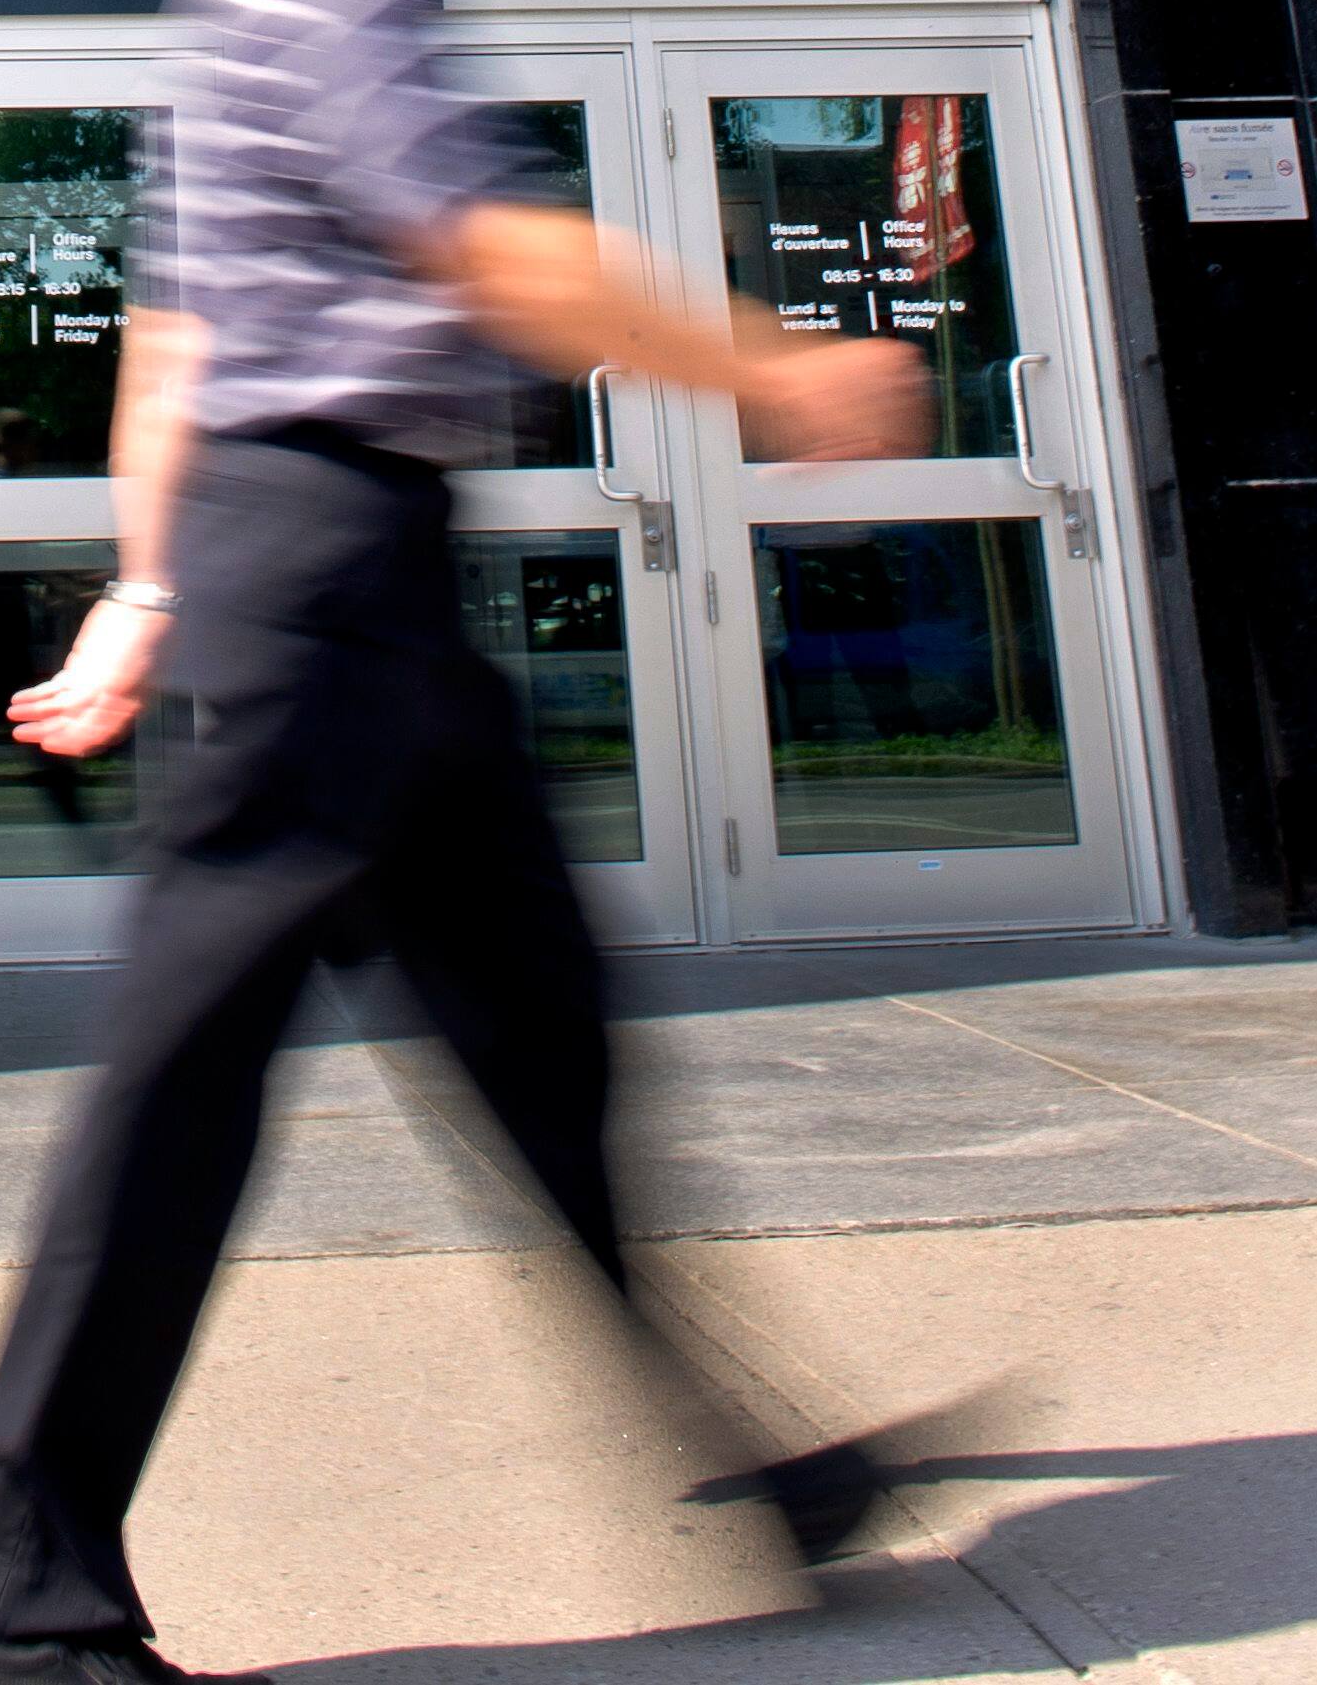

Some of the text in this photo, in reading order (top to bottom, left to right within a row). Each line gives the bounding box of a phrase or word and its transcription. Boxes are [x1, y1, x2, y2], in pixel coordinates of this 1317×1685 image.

[770, 222, 820, 235] Heures
[883, 219, 926, 233] Office
[53, 233, 97, 246] Office
[884, 235, 924, 249] Hours
[53, 248, 95, 261] Hours
[778, 302, 817, 316] Lundi
[891, 300, 966, 315] Monday to
[54, 314, 131, 329] Monday to
[781, 317, 841, 330] vendredi
[893, 315, 936, 330] Friday
[54, 330, 99, 345] Friday
